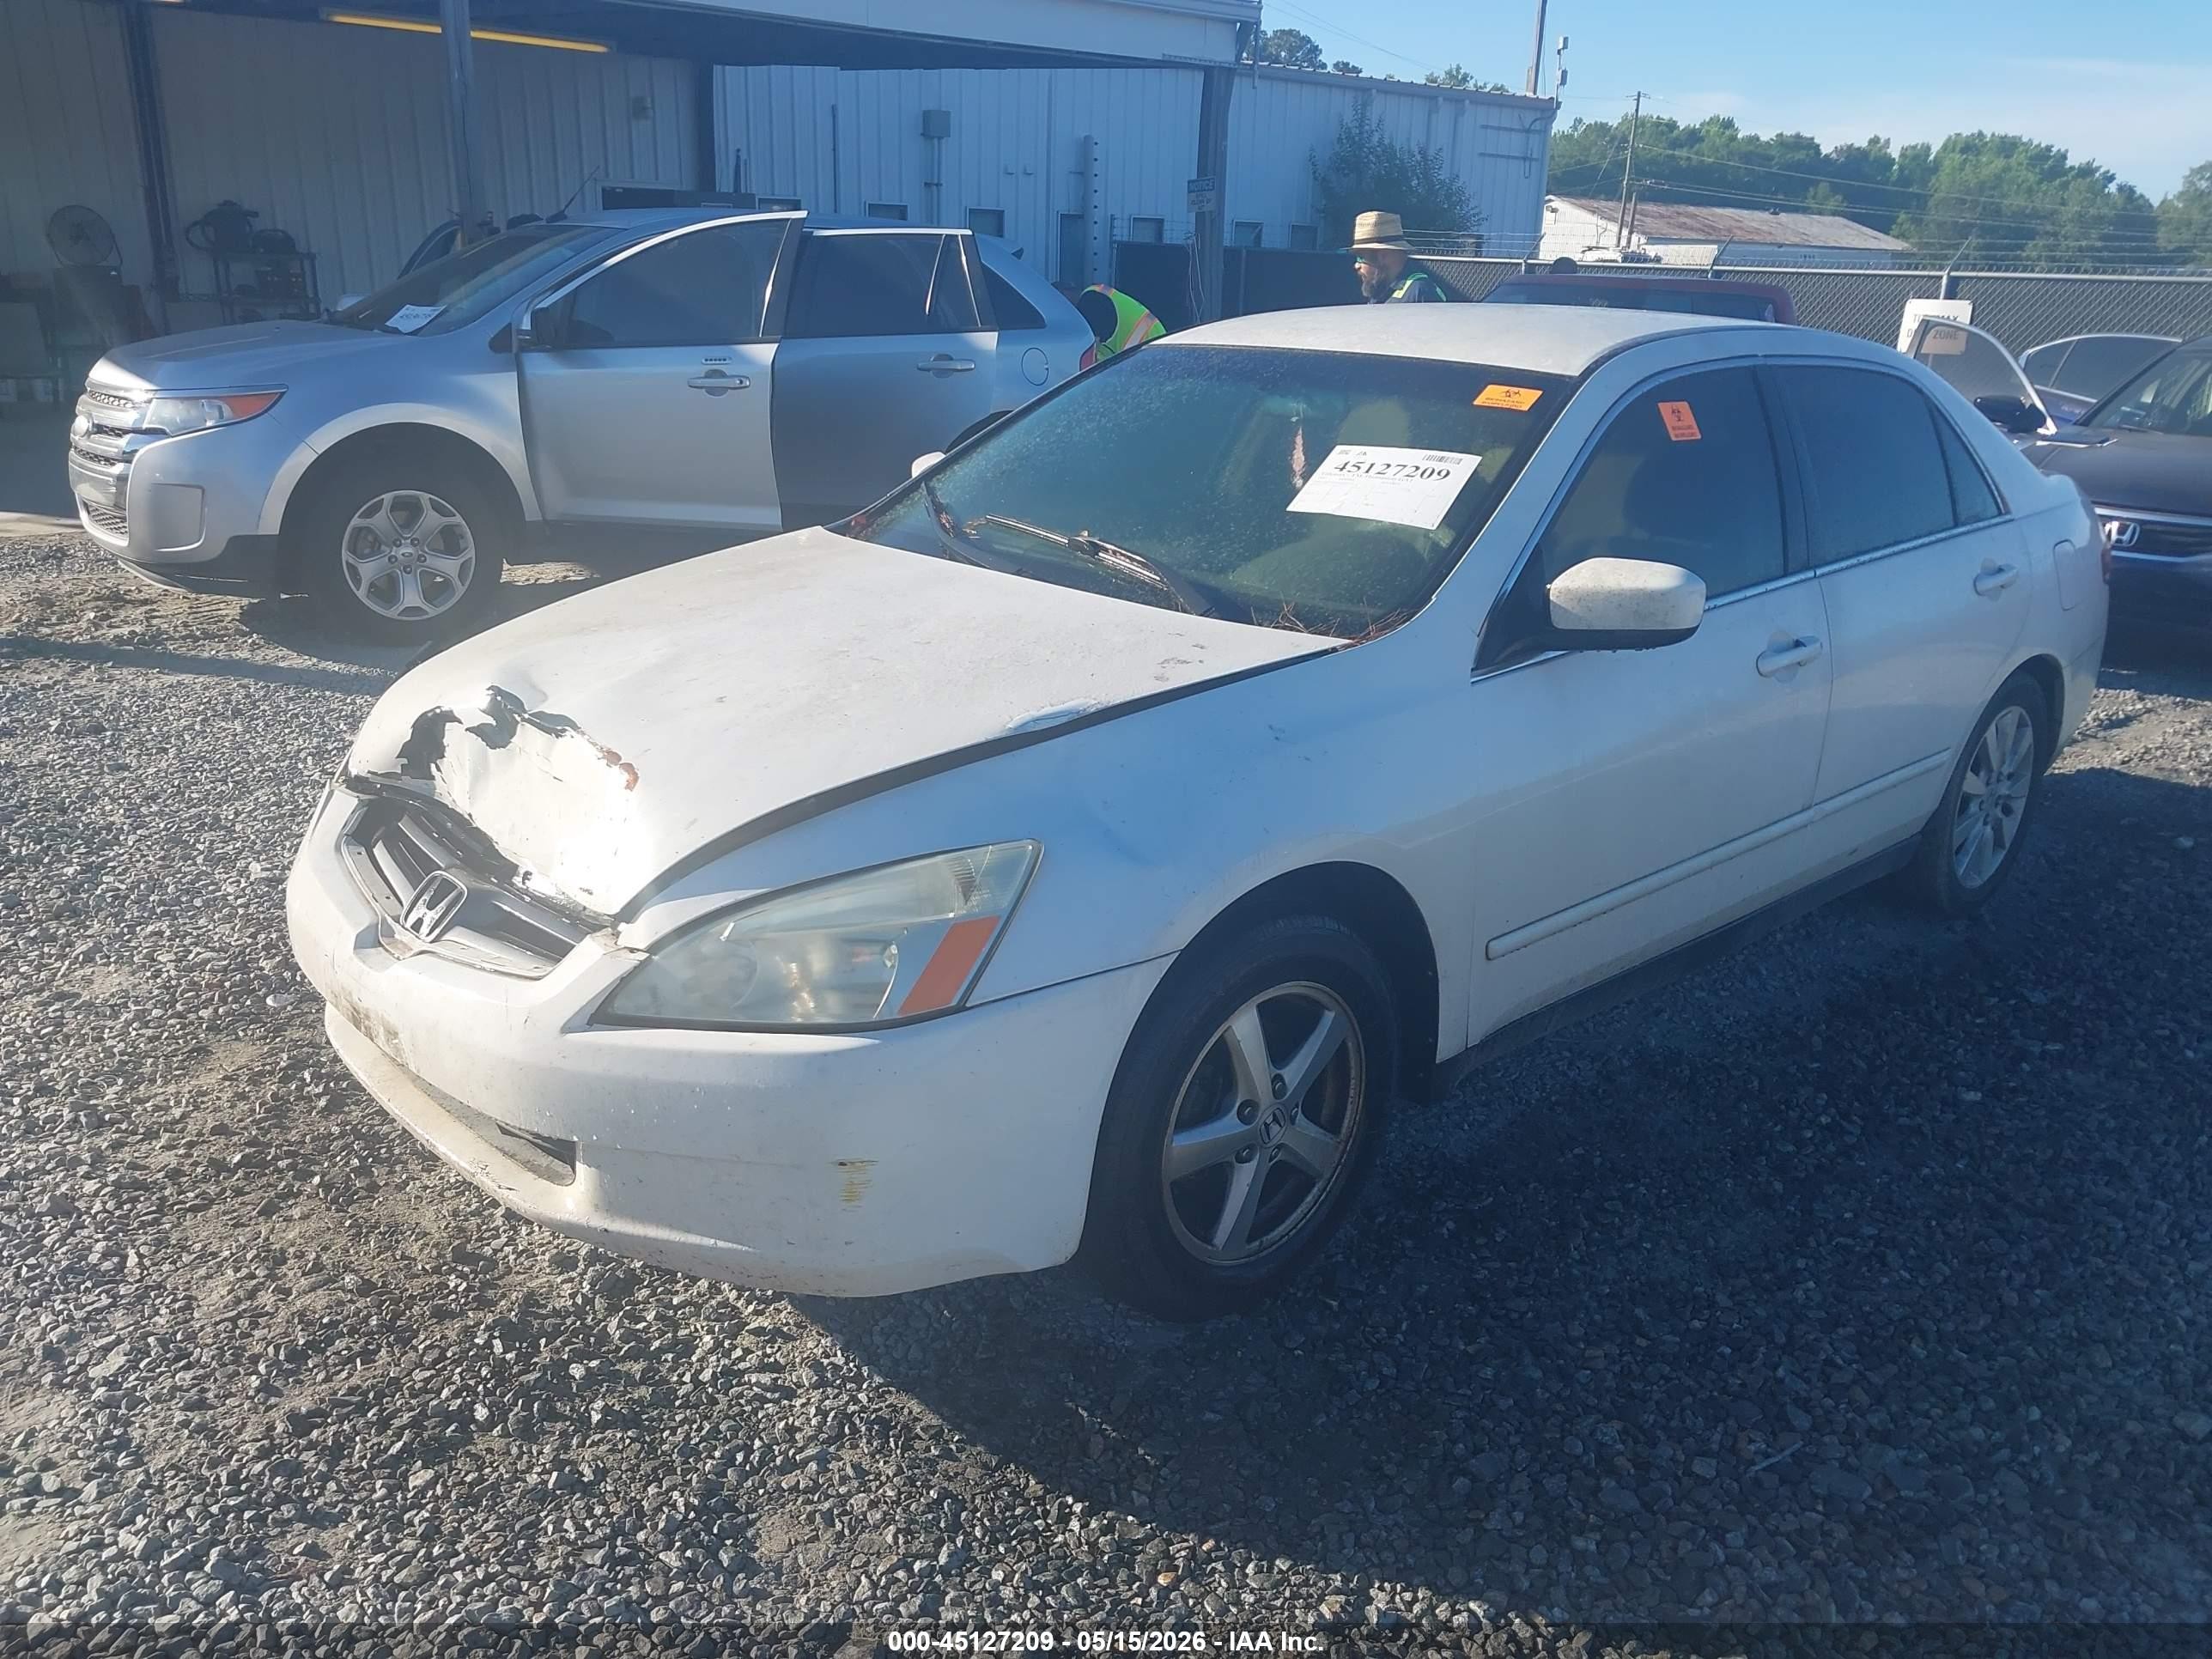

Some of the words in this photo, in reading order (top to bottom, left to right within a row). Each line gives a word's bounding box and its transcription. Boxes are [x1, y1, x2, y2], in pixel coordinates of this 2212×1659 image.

[1189, 179, 1214, 191] NOTICE
[1933, 329, 1959, 340] ZONE
[1334, 460, 1450, 481] 45127209
